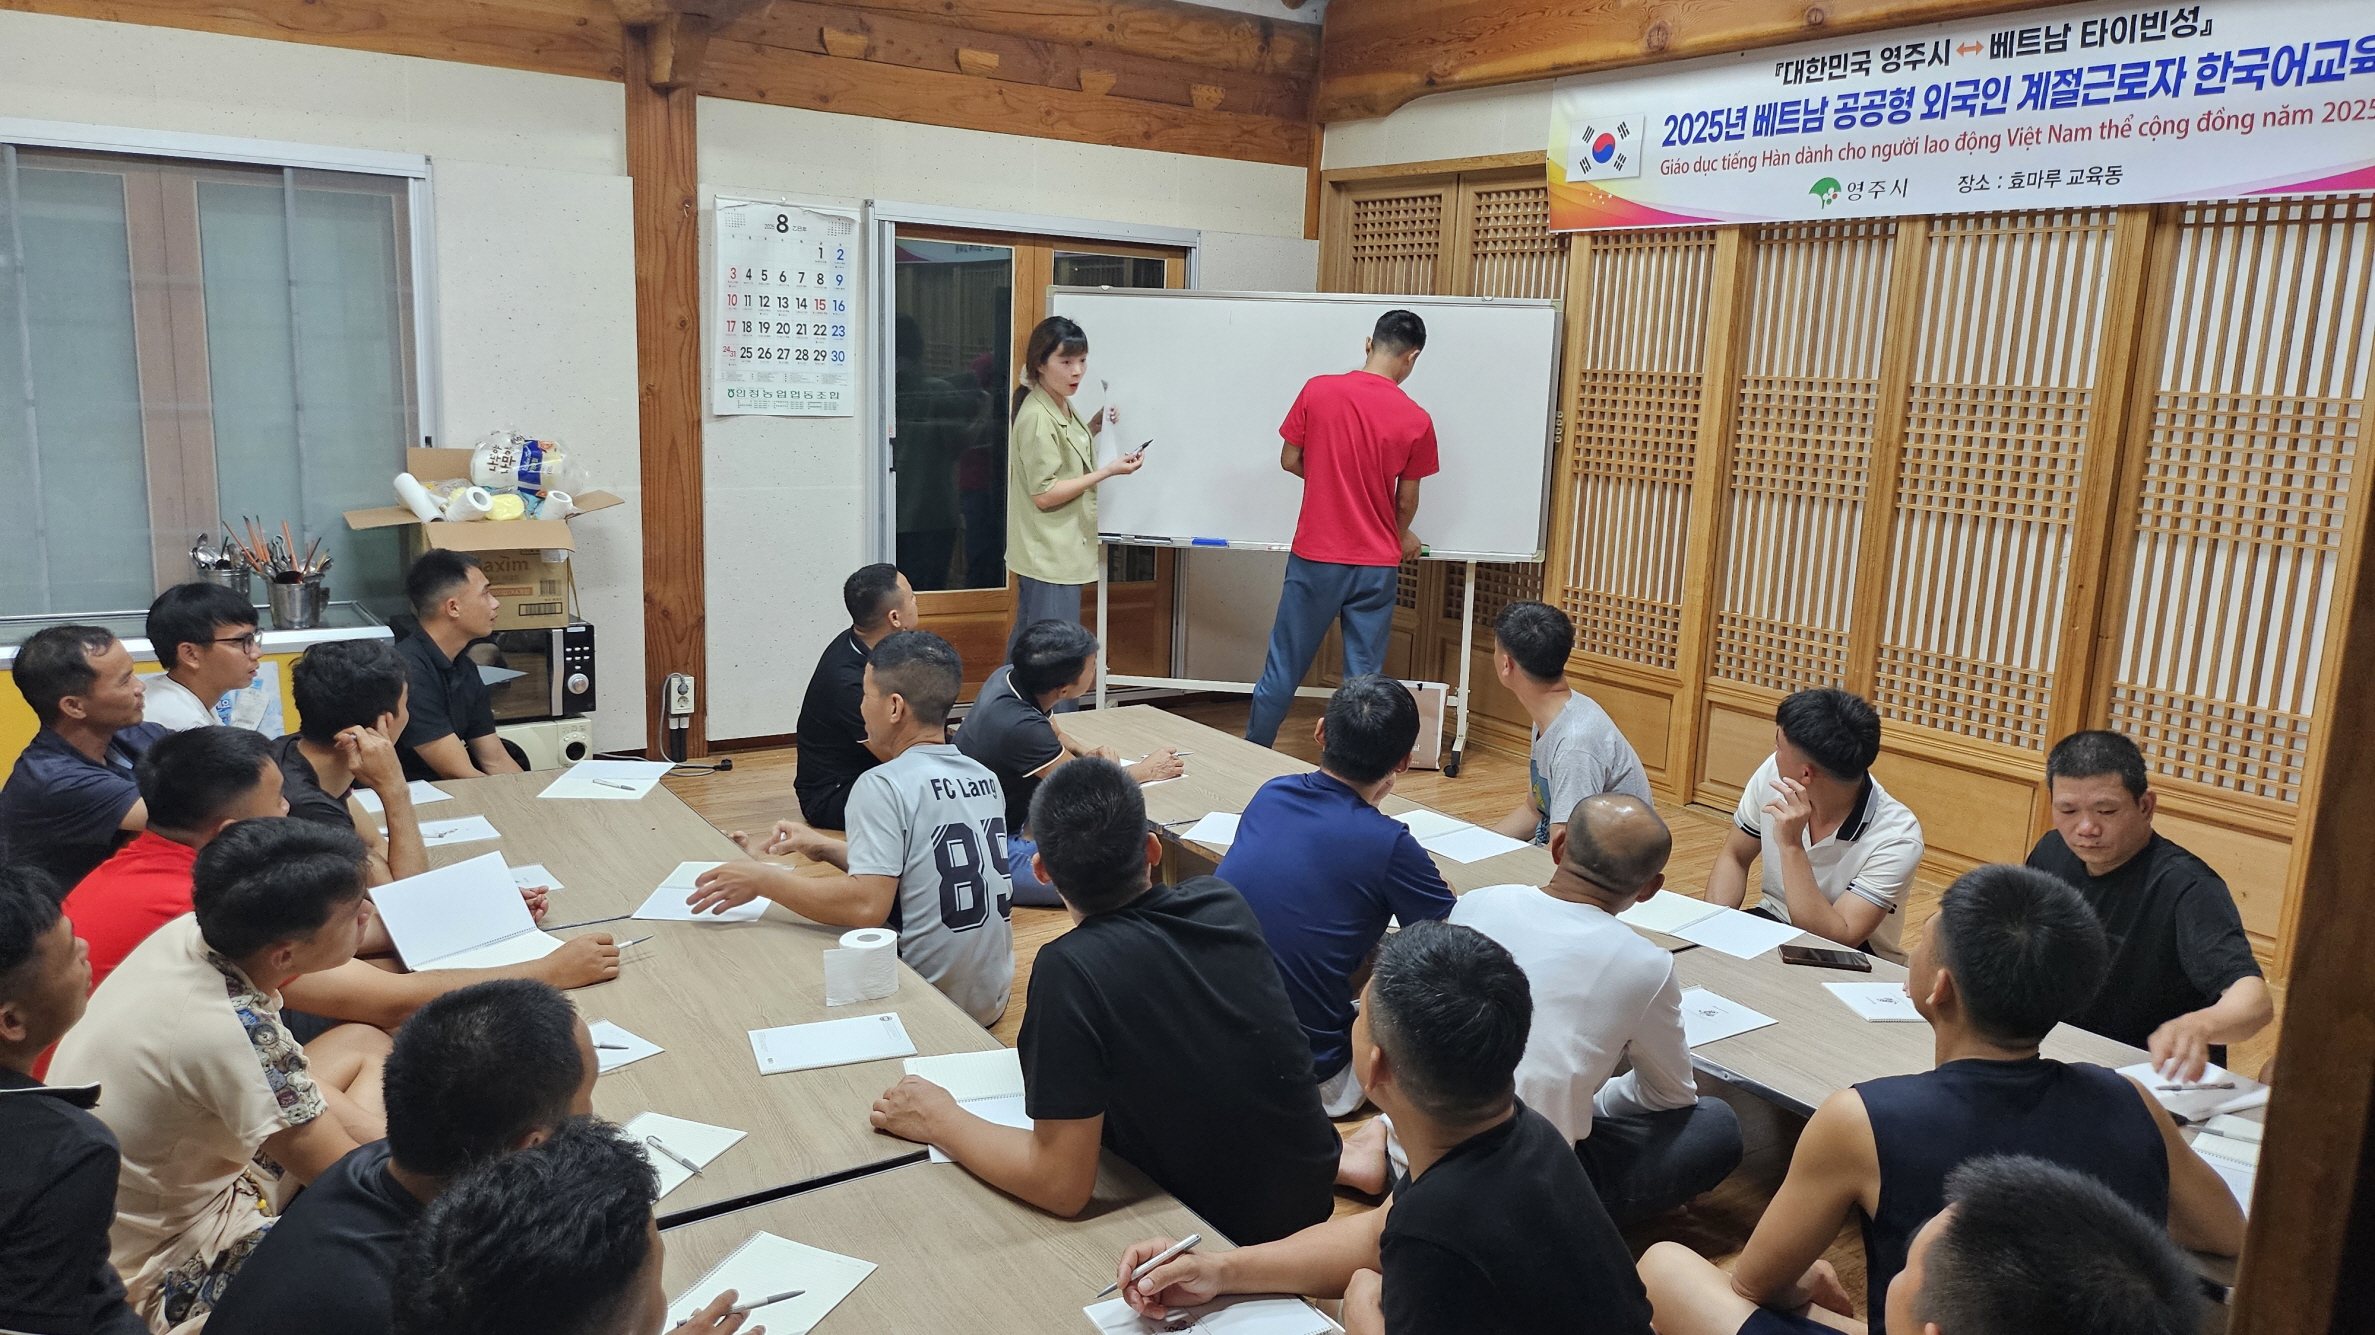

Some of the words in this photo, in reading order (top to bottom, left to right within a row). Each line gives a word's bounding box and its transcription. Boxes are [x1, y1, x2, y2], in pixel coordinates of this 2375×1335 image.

[1880, 38, 1951, 74] 영주시
[1989, 22, 2072, 60] 베트남
[1661, 104, 1749, 148] 2025년
[1751, 95, 1830, 138] 베트남
[1833, 85, 1917, 131] 공공형
[1919, 74, 2013, 121] 외국인
[2015, 55, 2188, 112] 계절근로자
[1660, 157, 1690, 176] Giáo
[1693, 155, 1718, 177] dục
[1721, 150, 1758, 173] tiếng
[1761, 147, 1790, 168] Hàn
[1795, 143, 1833, 165] dành
[1837, 141, 1867, 161] cho
[1871, 135, 1920, 163] người
[1923, 134, 1950, 155] lao
[1954, 130, 2002, 156] động
[2006, 125, 2043, 152] Việt
[2047, 123, 2093, 145] Nam
[2099, 113, 2135, 141] thể
[2138, 114, 2190, 142] cộng
[2196, 106, 2255, 136] đồng
[2262, 103, 2314, 128] năm
[1847, 177, 1908, 202] 영주시
[1957, 173, 1991, 194] 장소
[2007, 169, 2062, 190] 효마루
[2065, 165, 2124, 186] 교육동
[776, 213, 789, 233] 8
[818, 246, 823, 259] 1
[836, 248, 845, 261] 2
[729, 267, 737, 279] 3
[745, 268, 753, 280] 4
[761, 269, 768, 282] 5
[779, 271, 787, 283] 6
[798, 271, 805, 283] 7
[816, 273, 825, 285] 8
[835, 274, 844, 286] 9
[727, 293, 738, 306] 10
[744, 294, 752, 307] 11
[758, 295, 770, 308] 12
[777, 296, 789, 309] 13
[795, 297, 808, 310] 14
[814, 298, 826, 311] 15
[832, 299, 846, 312] 16
[726, 320, 736, 333] 17
[742, 320, 752, 333] 18
[758, 321, 770, 334] 19
[776, 322, 791, 335] 20
[795, 323, 807, 336] 21
[813, 324, 827, 336] 22
[831, 325, 846, 337] 23
[722, 345, 731, 353] 24
[729, 350, 736, 358] 31
[740, 346, 753, 359] 25
[757, 347, 772, 360] 26
[776, 348, 791, 360] 27
[795, 348, 809, 361] 28
[813, 349, 828, 362] 29
[831, 350, 846, 362] 30
[482, 556, 529, 573] axim
[930, 777, 956, 801] FC
[956, 777, 998, 800] Làng
